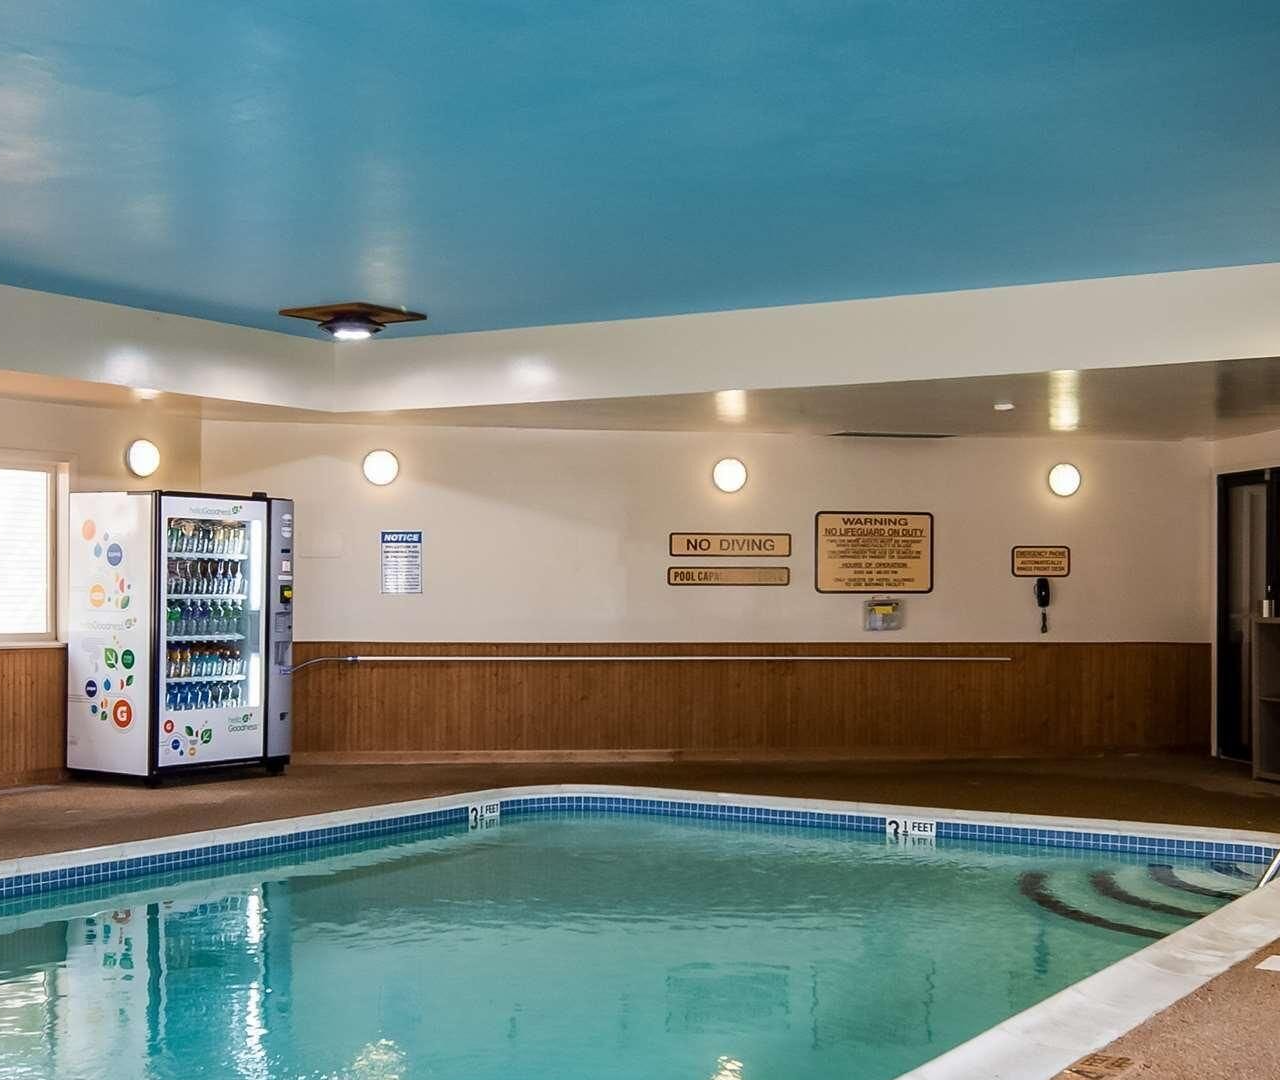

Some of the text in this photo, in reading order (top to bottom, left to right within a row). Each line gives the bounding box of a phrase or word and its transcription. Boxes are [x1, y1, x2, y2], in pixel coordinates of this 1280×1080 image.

[842, 517, 908, 526] WARNING
[384, 533, 419, 541] NOTICE
[824, 528, 837, 536] NO
[839, 528, 885, 536] LIFEGUARD
[888, 528, 900, 536] ON
[686, 539, 775, 551] NO DIVING
[673, 571, 696, 582] POOL
[486, 803, 499, 814] FEET
[912, 822, 934, 833] FEET
